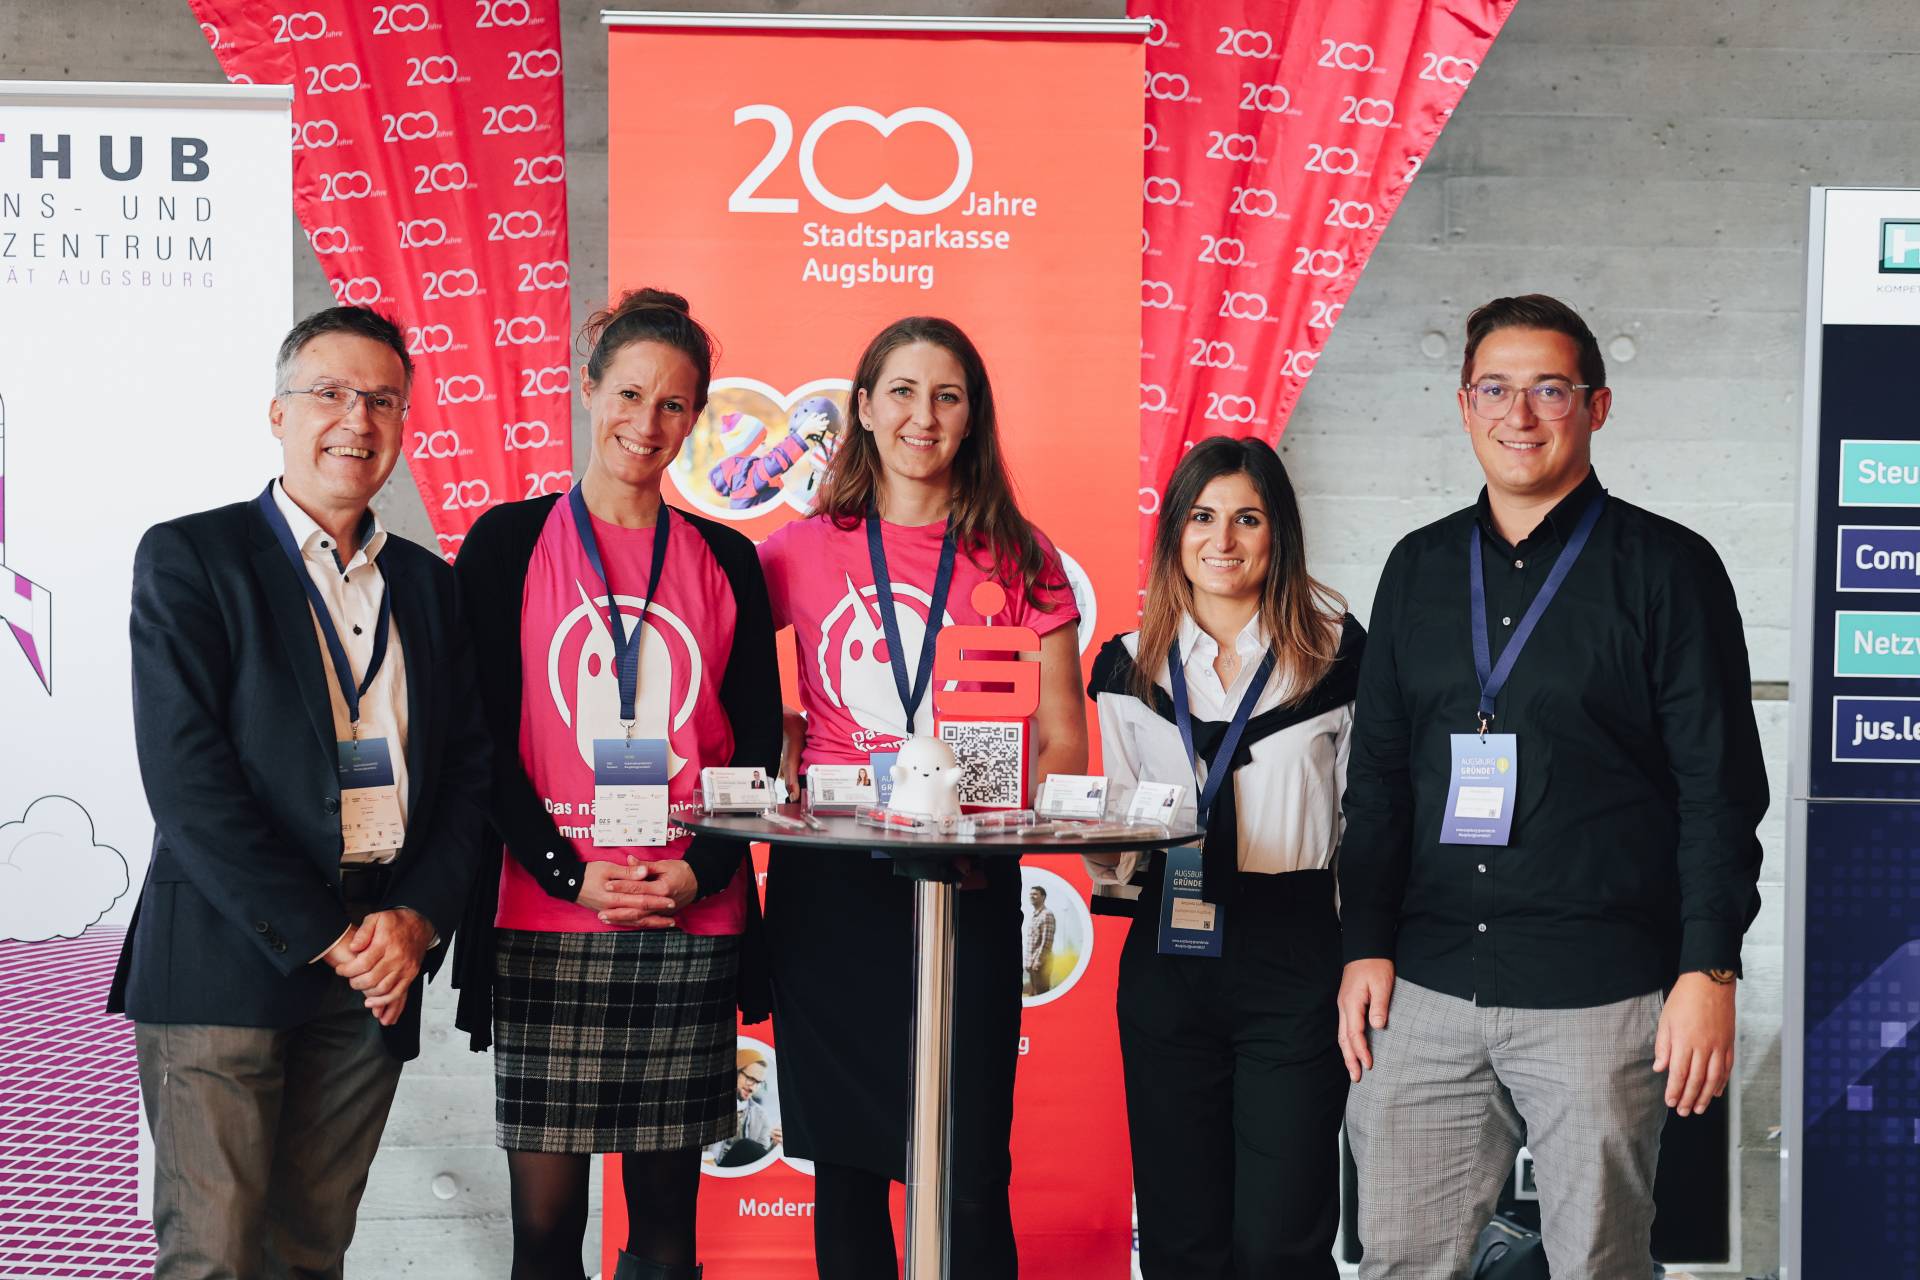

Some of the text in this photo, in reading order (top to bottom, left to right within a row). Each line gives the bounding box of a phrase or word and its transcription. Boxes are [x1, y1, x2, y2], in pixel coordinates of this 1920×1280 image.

[272, 11, 327, 43] 200
[372, 3, 429, 35] 200
[475, 0, 530, 28] 200
[1216, 26, 1273, 59] 200
[1317, 38, 1375, 72] 200
[304, 62, 361, 95] 200
[406, 55, 458, 87] 200
[507, 49, 561, 81] 200
[1419, 52, 1478, 87] 200
[1239, 82, 1291, 113] 200
[1338, 95, 1394, 128] 200
[382, 111, 438, 143] 200
[482, 104, 537, 135] 200
[0, 134, 209, 182] HUB
[728, 104, 1037, 217] 200 Jahre
[1206, 131, 1257, 162] 200
[1304, 143, 1359, 175] 200
[319, 170, 372, 202] 200
[414, 162, 467, 194] 200
[513, 155, 565, 187] 200
[3, 193, 211, 222] NS- UND
[1229, 186, 1278, 217] 200
[1324, 199, 1374, 229] 200
[304, 226, 349, 254] 00
[397, 218, 446, 249] 200
[487, 210, 543, 241] 200
[802, 222, 1010, 253] Stadtsparkasse
[2, 232, 212, 261] ZENTRUM
[1198, 234, 1245, 266] 200
[1291, 246, 1344, 278] 200
[6, 266, 213, 288] ÄT AUGSBURG
[422, 268, 478, 301] 200
[518, 260, 569, 292] 200
[801, 258, 935, 290] Augsburg
[1876, 284, 1920, 294] KOMPE
[329, 277, 382, 306] 200
[1219, 290, 1268, 321] 200
[1308, 301, 1344, 328] 20
[407, 323, 453, 355] 200
[493, 316, 546, 347] 200
[1190, 338, 1235, 369] 200
[1280, 349, 1321, 378] 20
[435, 375, 484, 406] 200
[521, 366, 570, 397] 200
[1204, 392, 1256, 423] 200
[413, 430, 459, 459] 200
[503, 420, 549, 451] 200
[524, 470, 572, 500] 200
[1858, 459, 1919, 485] Steu
[442, 479, 490, 510] 200
[1854, 630, 1920, 656] Netz
[544, 797, 572, 815] Das
